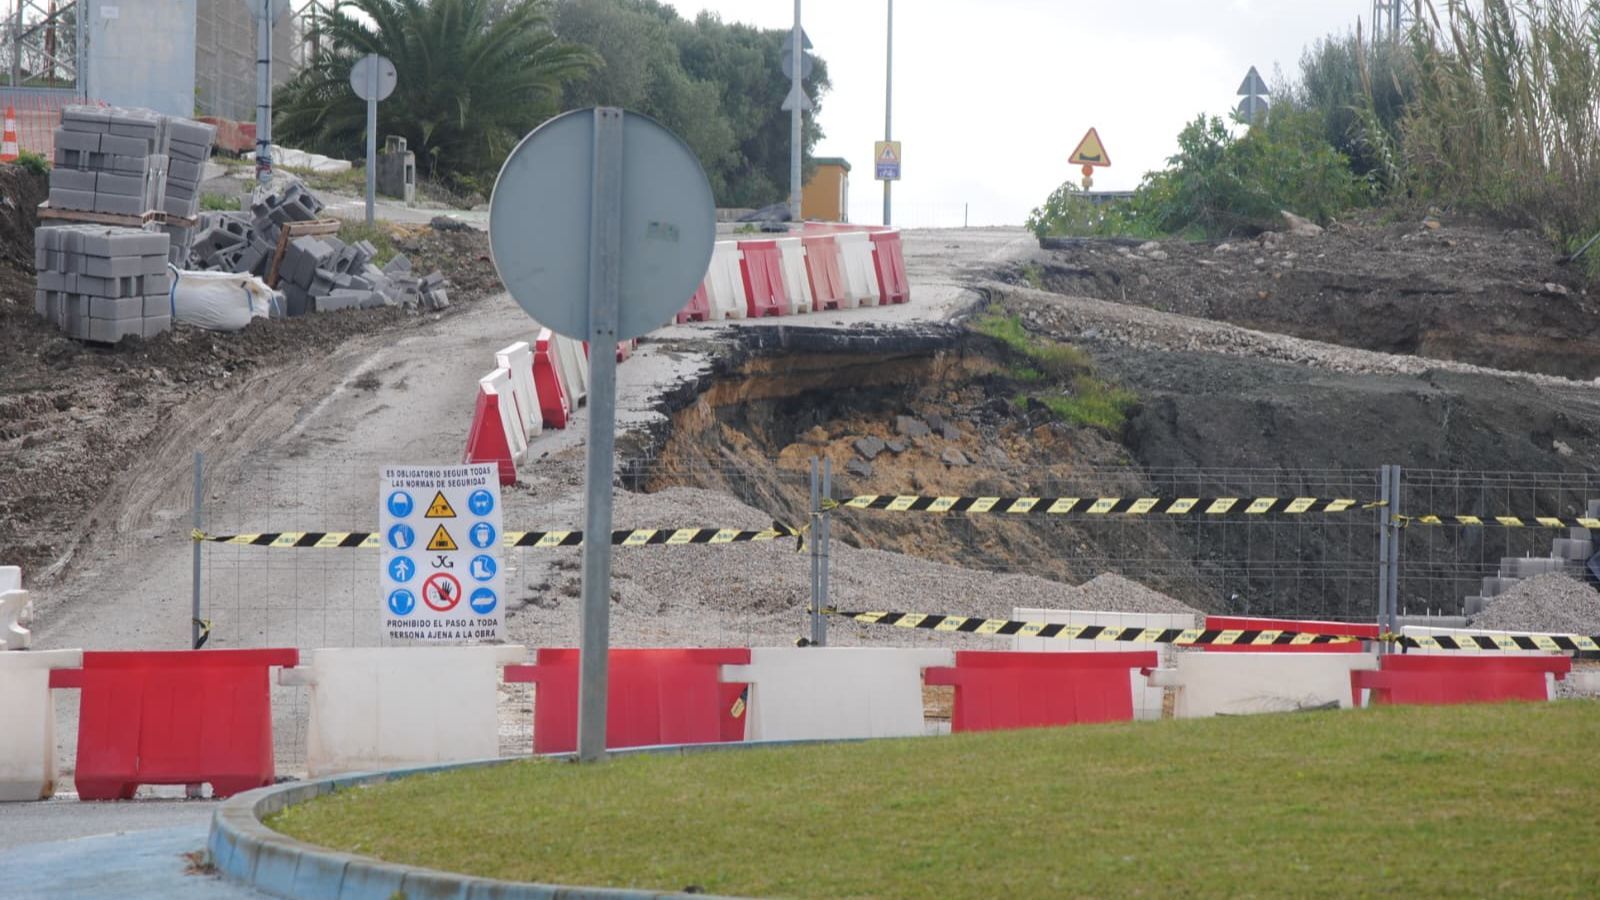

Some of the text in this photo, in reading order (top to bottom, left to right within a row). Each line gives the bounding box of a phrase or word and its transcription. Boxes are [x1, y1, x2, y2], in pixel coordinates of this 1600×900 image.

[396, 469, 441, 478] OBLIGATORIO
[443, 468, 468, 478] SEGUIR
[470, 466, 491, 475] TODAS
[406, 480, 434, 488] NORMAS
[436, 480, 445, 488] DE
[448, 477, 486, 488] SEGURIDAD
[387, 618, 498, 628] PROHIBIDO EL PASO A TODA
[427, 630, 453, 639] AJENA
[462, 630, 472, 638] LA
[474, 629, 496, 638] OBRA
